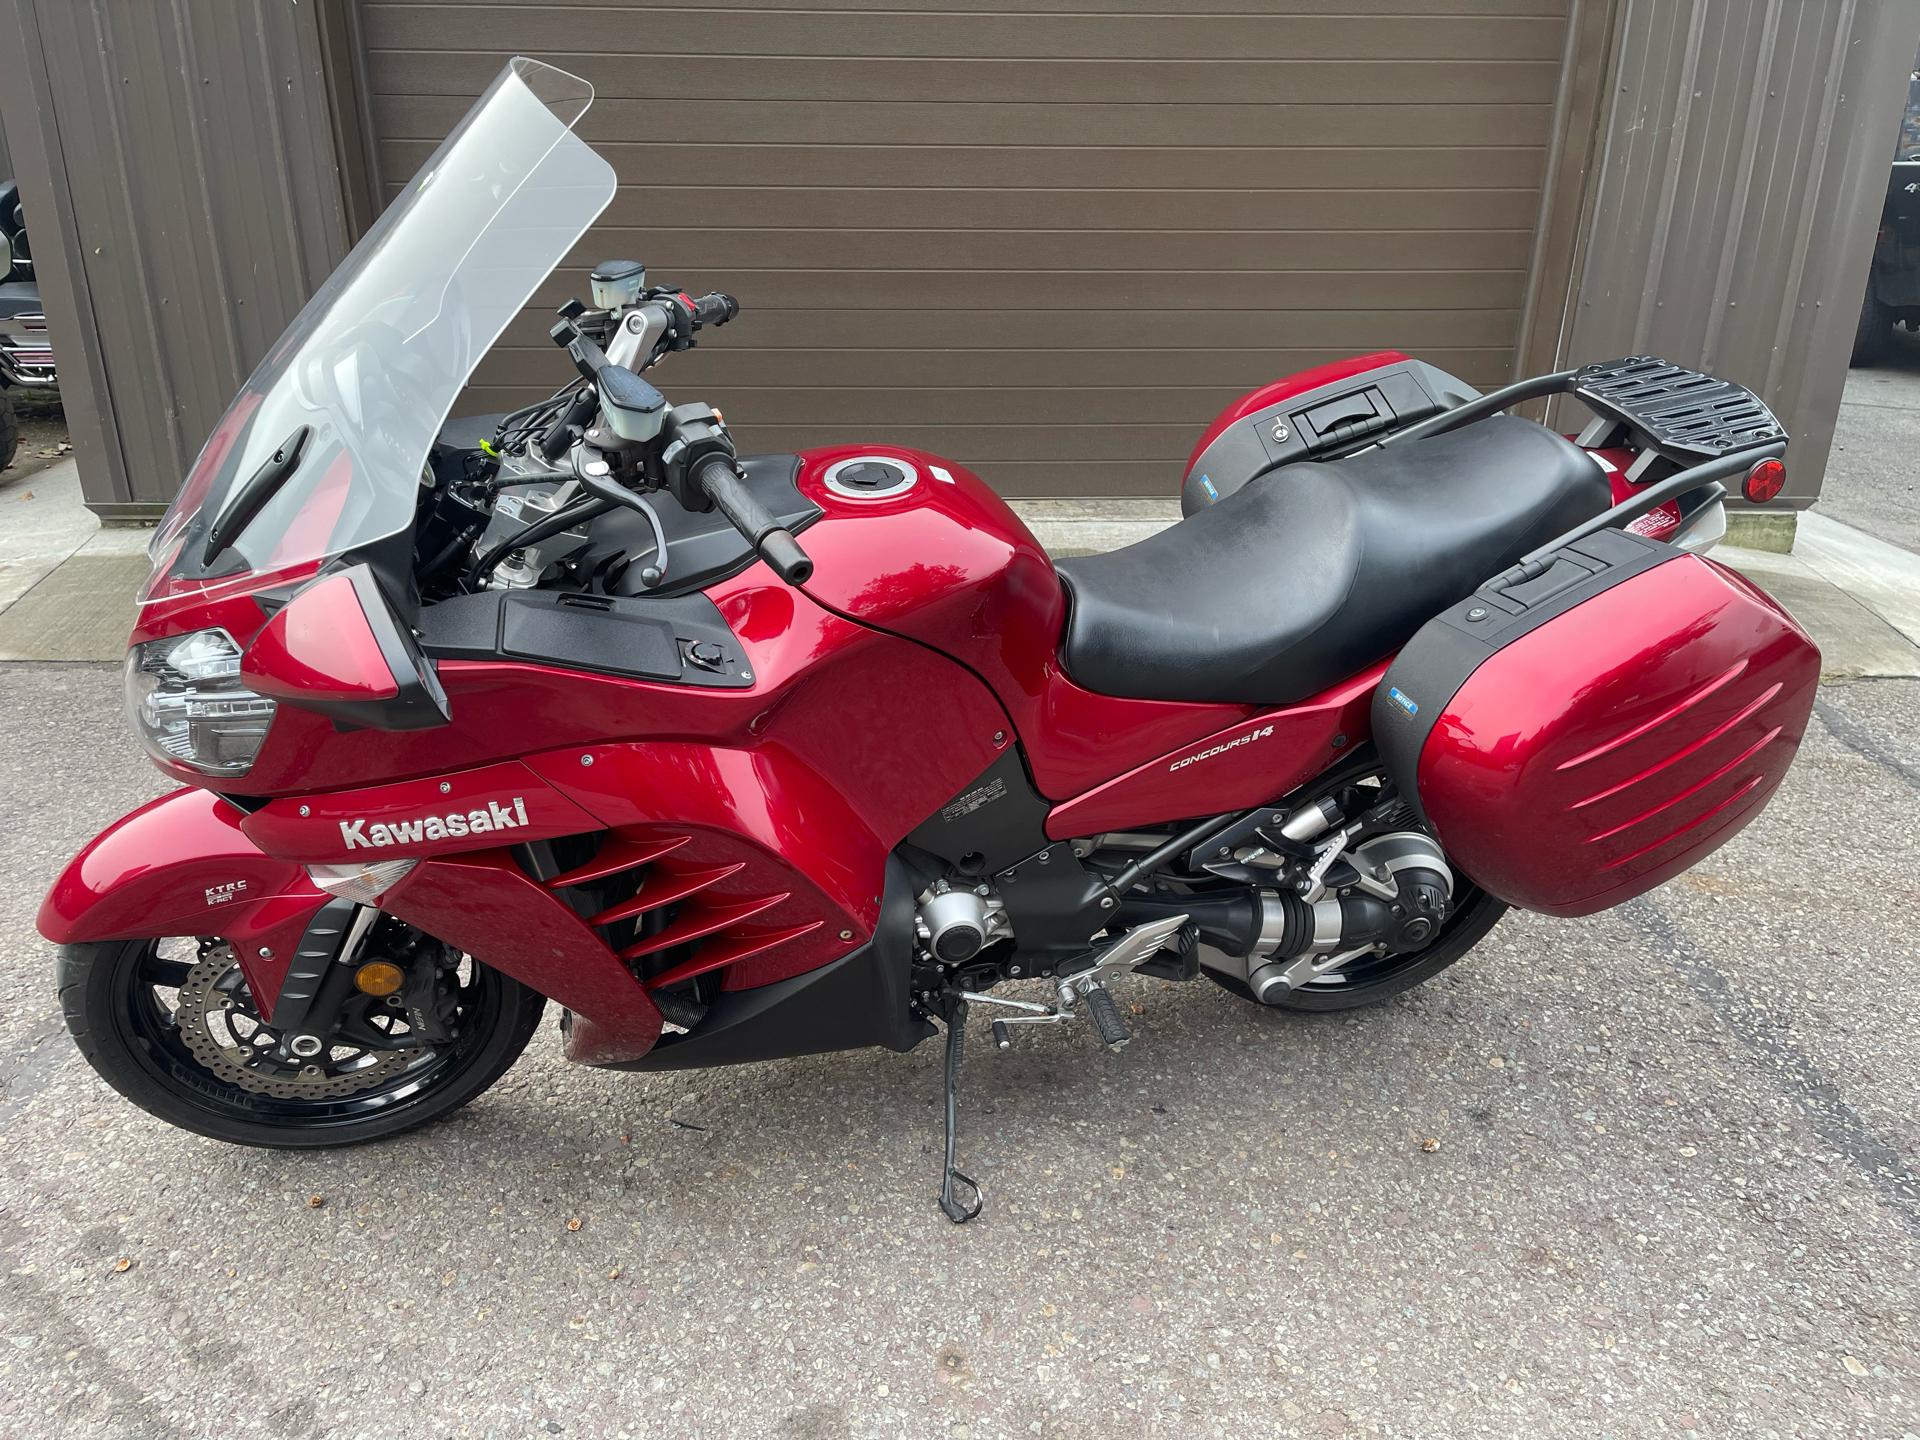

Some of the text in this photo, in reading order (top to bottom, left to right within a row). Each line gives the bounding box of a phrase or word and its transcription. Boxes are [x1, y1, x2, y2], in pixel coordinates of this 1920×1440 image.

[1395, 693, 1413, 709] NOTICE
[339, 797, 529, 850] Kawasaki
[205, 879, 247, 896] KTRC
